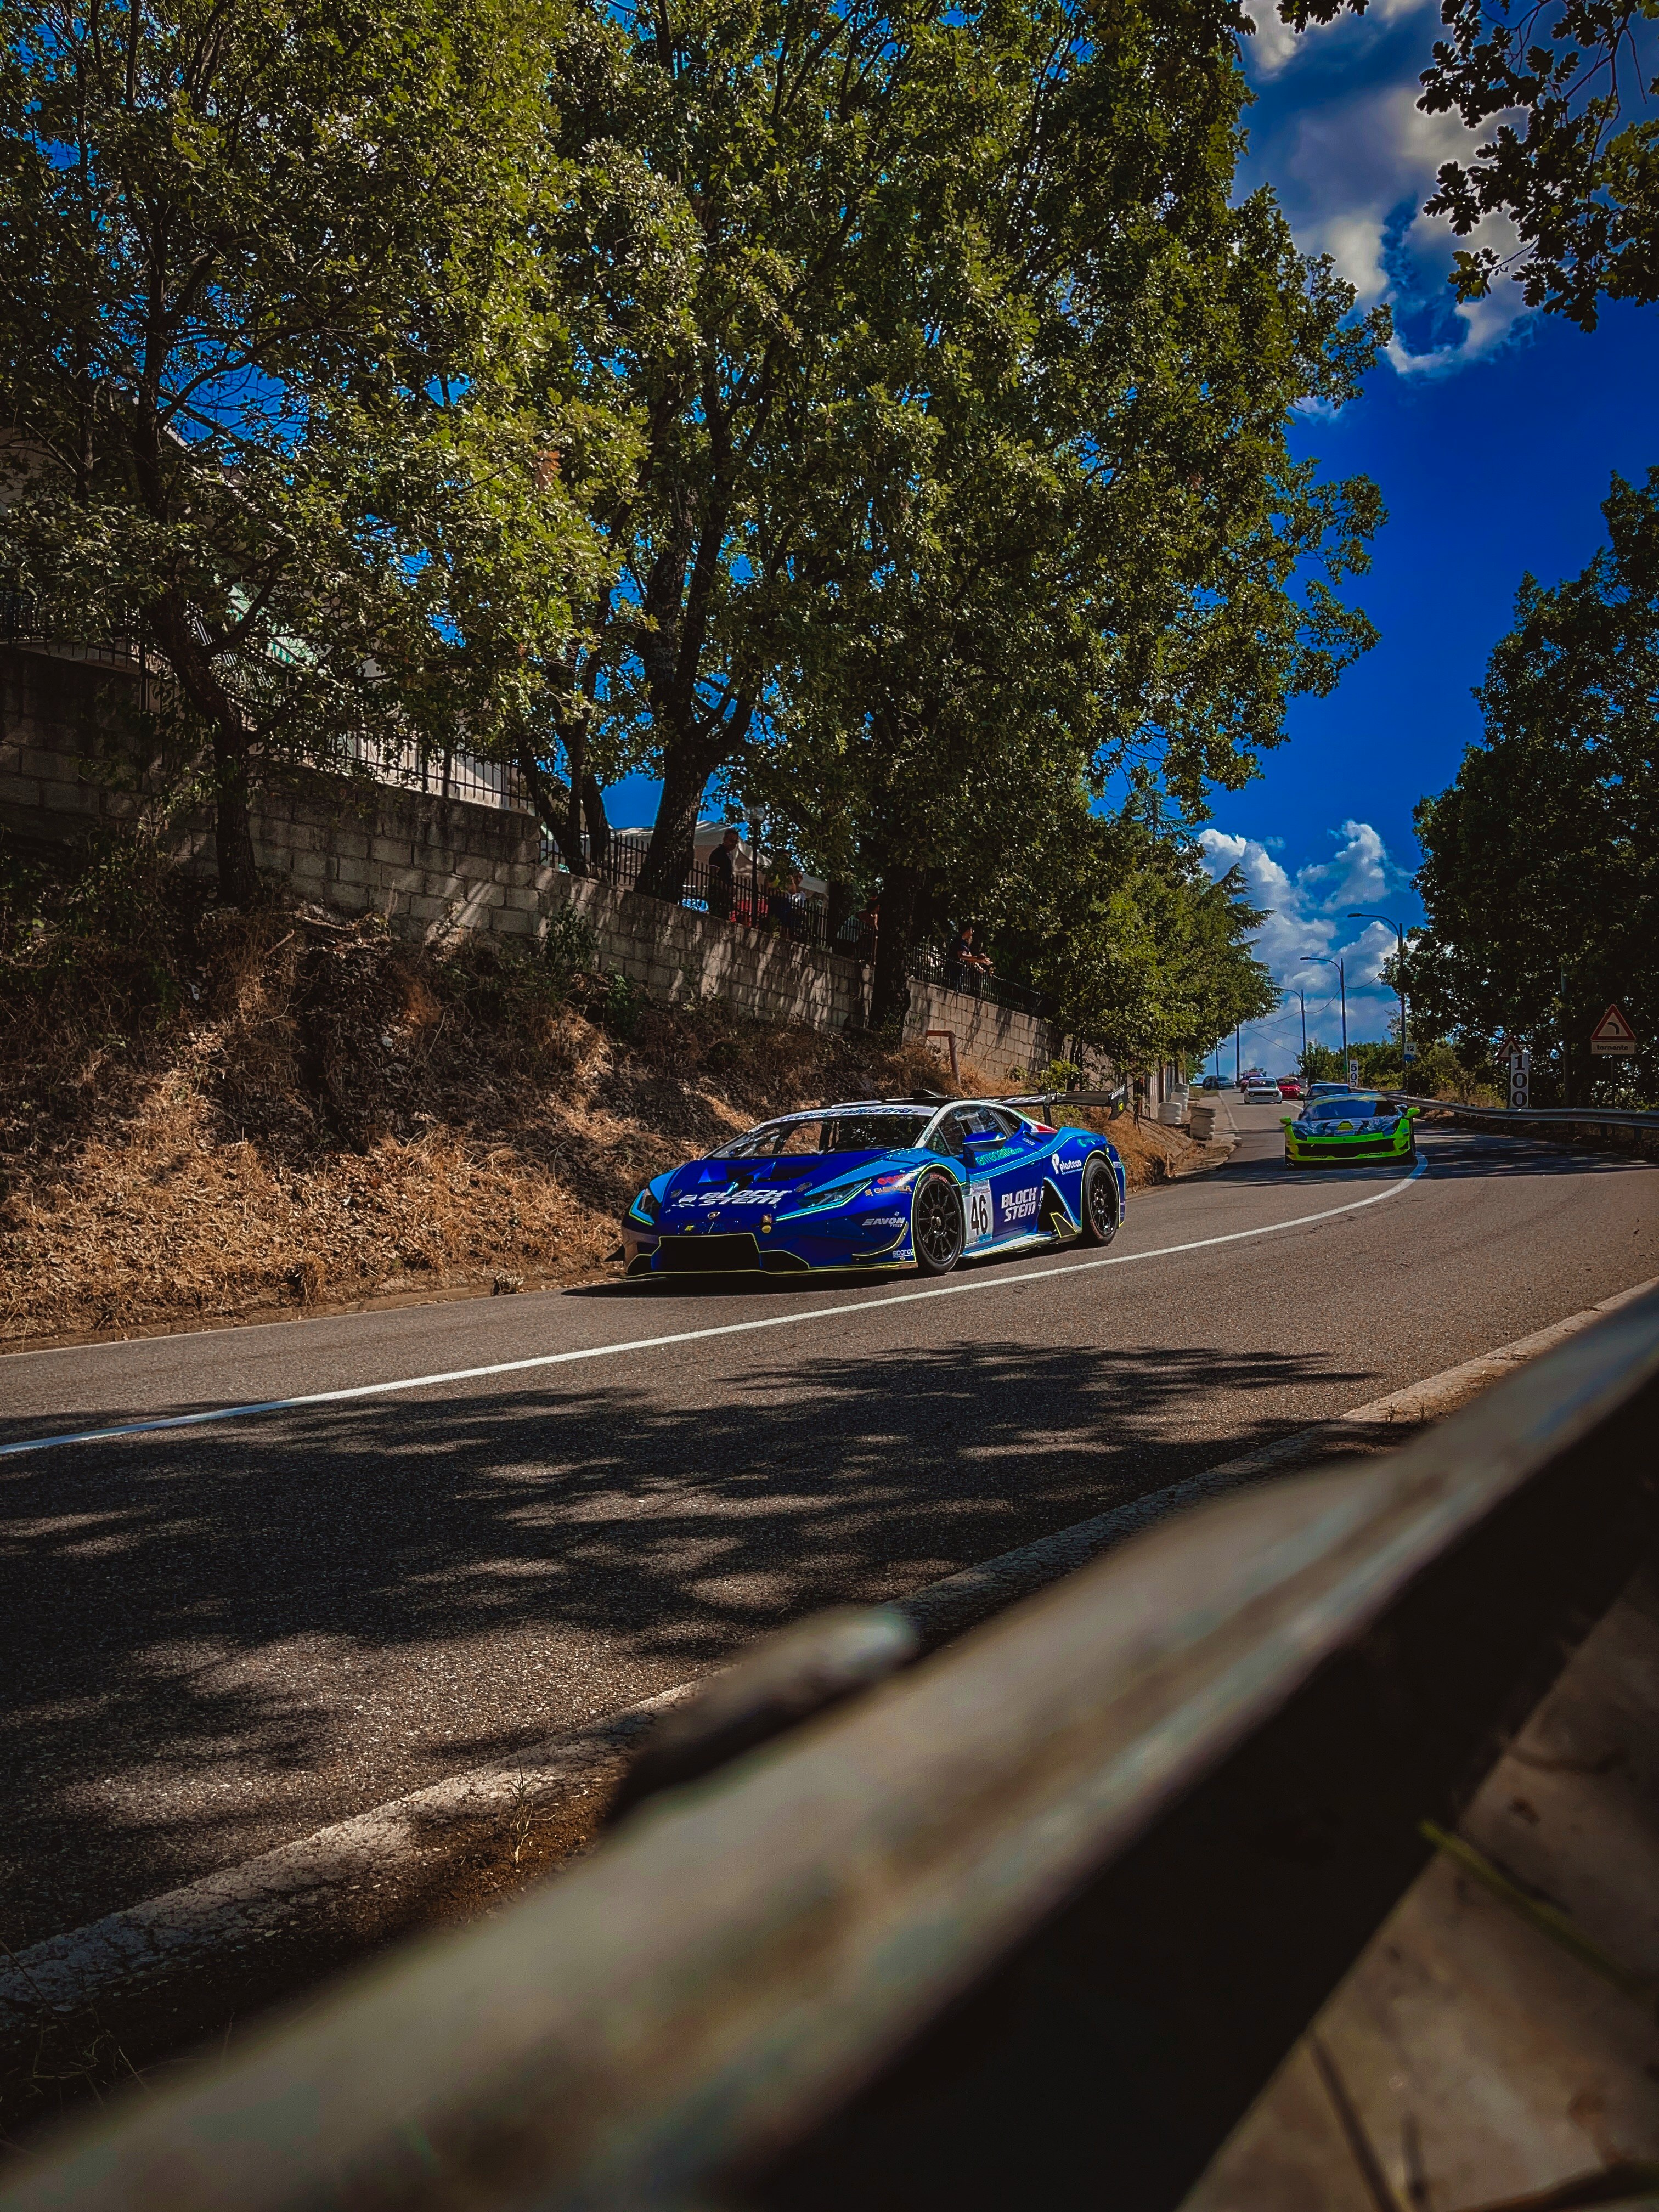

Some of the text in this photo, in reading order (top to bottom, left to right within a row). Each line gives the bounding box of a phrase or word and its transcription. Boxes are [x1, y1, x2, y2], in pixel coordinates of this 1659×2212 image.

[1512, 1054, 1528, 1107] 100
[1059, 1160, 1082, 1173] plasteco
[698, 1190, 789, 1200] BLOCK
[698, 1197, 781, 1206] STEM
[1001, 1187, 1036, 1209] BLOCK
[970, 1194, 988, 1236] 46
[1003, 1201, 1036, 1222] STEM
